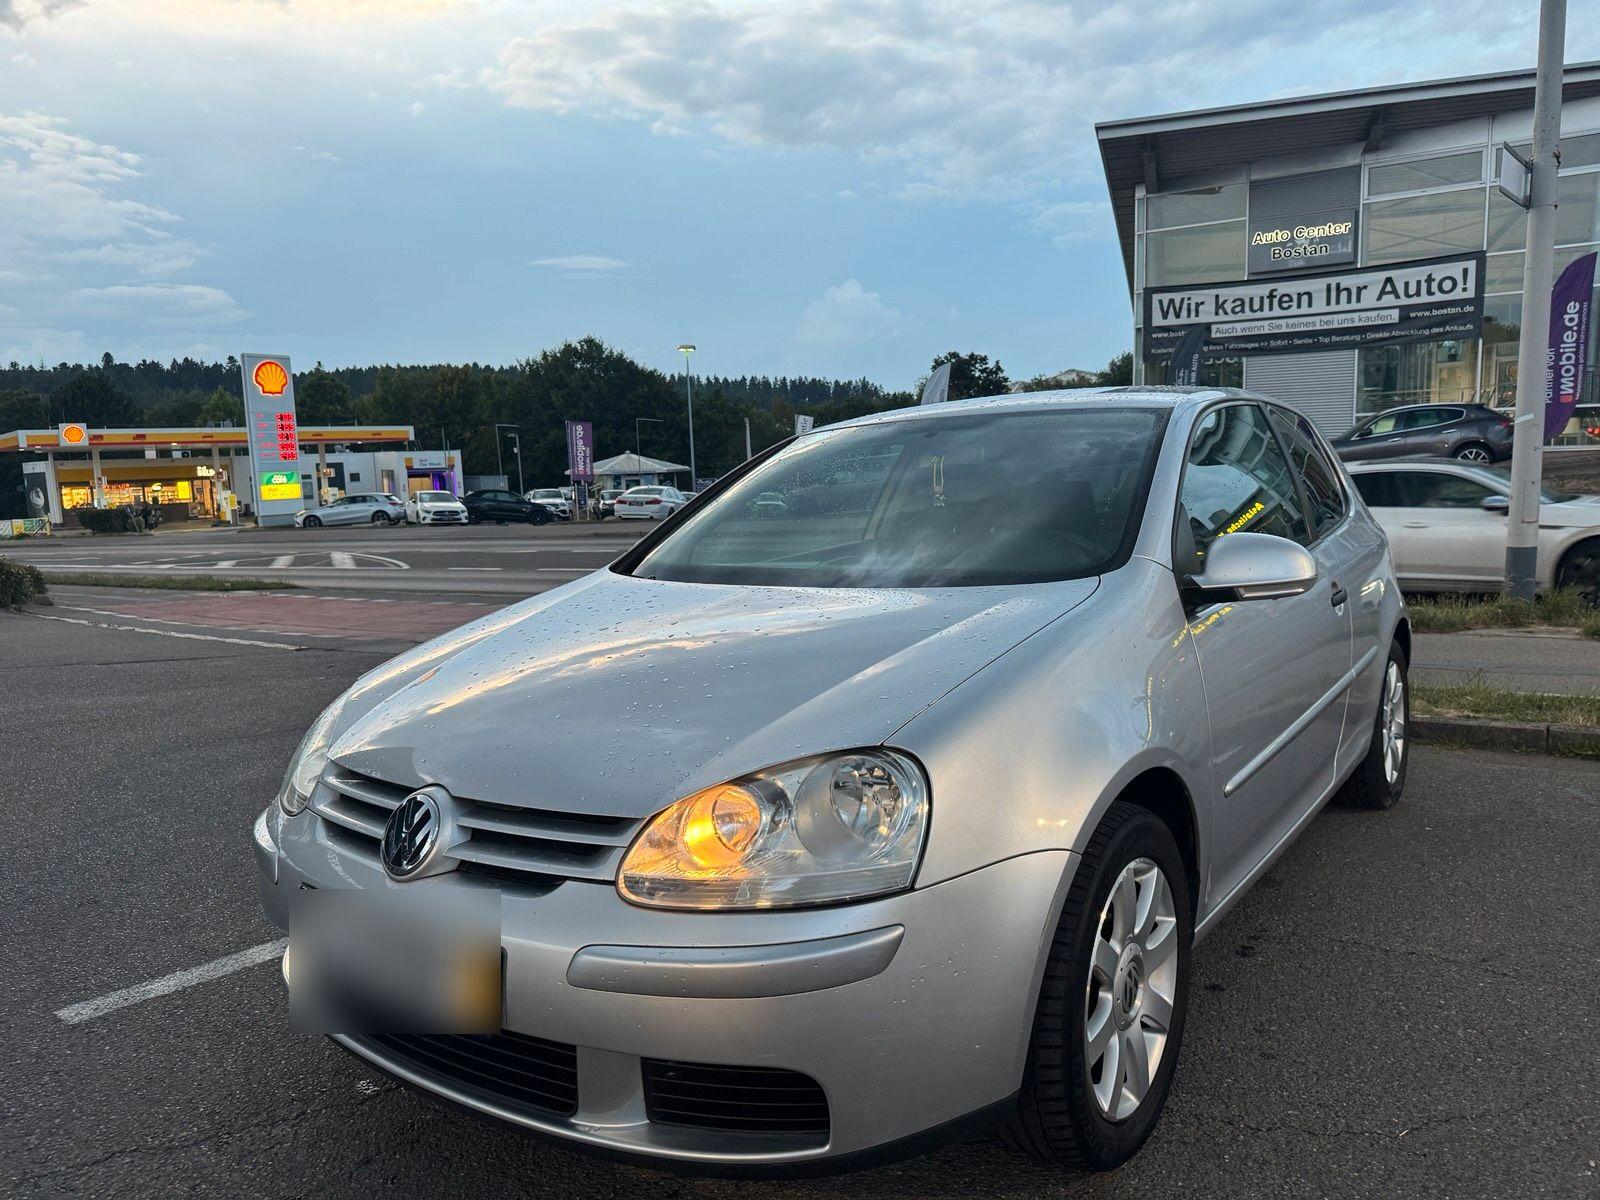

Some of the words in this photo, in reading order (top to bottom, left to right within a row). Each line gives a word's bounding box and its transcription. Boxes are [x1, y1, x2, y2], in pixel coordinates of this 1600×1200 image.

[1252, 229, 1291, 246] Auto
[1293, 222, 1352, 240] Center
[1271, 244, 1330, 261] Bostan
[1158, 297, 1205, 320] Wir
[1214, 289, 1313, 317] kaufen
[1325, 282, 1368, 307] Ihr
[1376, 267, 1469, 302] Auto!
[1409, 304, 1475, 318] www.bostan.de
[1214, 325, 1238, 336] Auch
[1240, 325, 1265, 334] wenn
[1267, 322, 1283, 331] Sie
[1285, 319, 1317, 330] keines
[1319, 316, 1334, 327] bei
[1337, 316, 1355, 326] uns
[1358, 313, 1396, 324] kaufen.
[1318, 335, 1330, 343] Top
[1331, 333, 1361, 343] Beratung
[1366, 331, 1390, 340] Direkte
[1390, 328, 1430, 338] Abwicklung
[1430, 325, 1444, 333] des
[1444, 323, 1474, 332] Ankaufs
[1151, 330, 1187, 339] www.bost
[1269, 338, 1288, 347] Sofort
[1293, 337, 1313, 345] Seriös
[1559, 301, 1580, 395] mobile.de
[1190, 353, 1199, 371] AUTO
